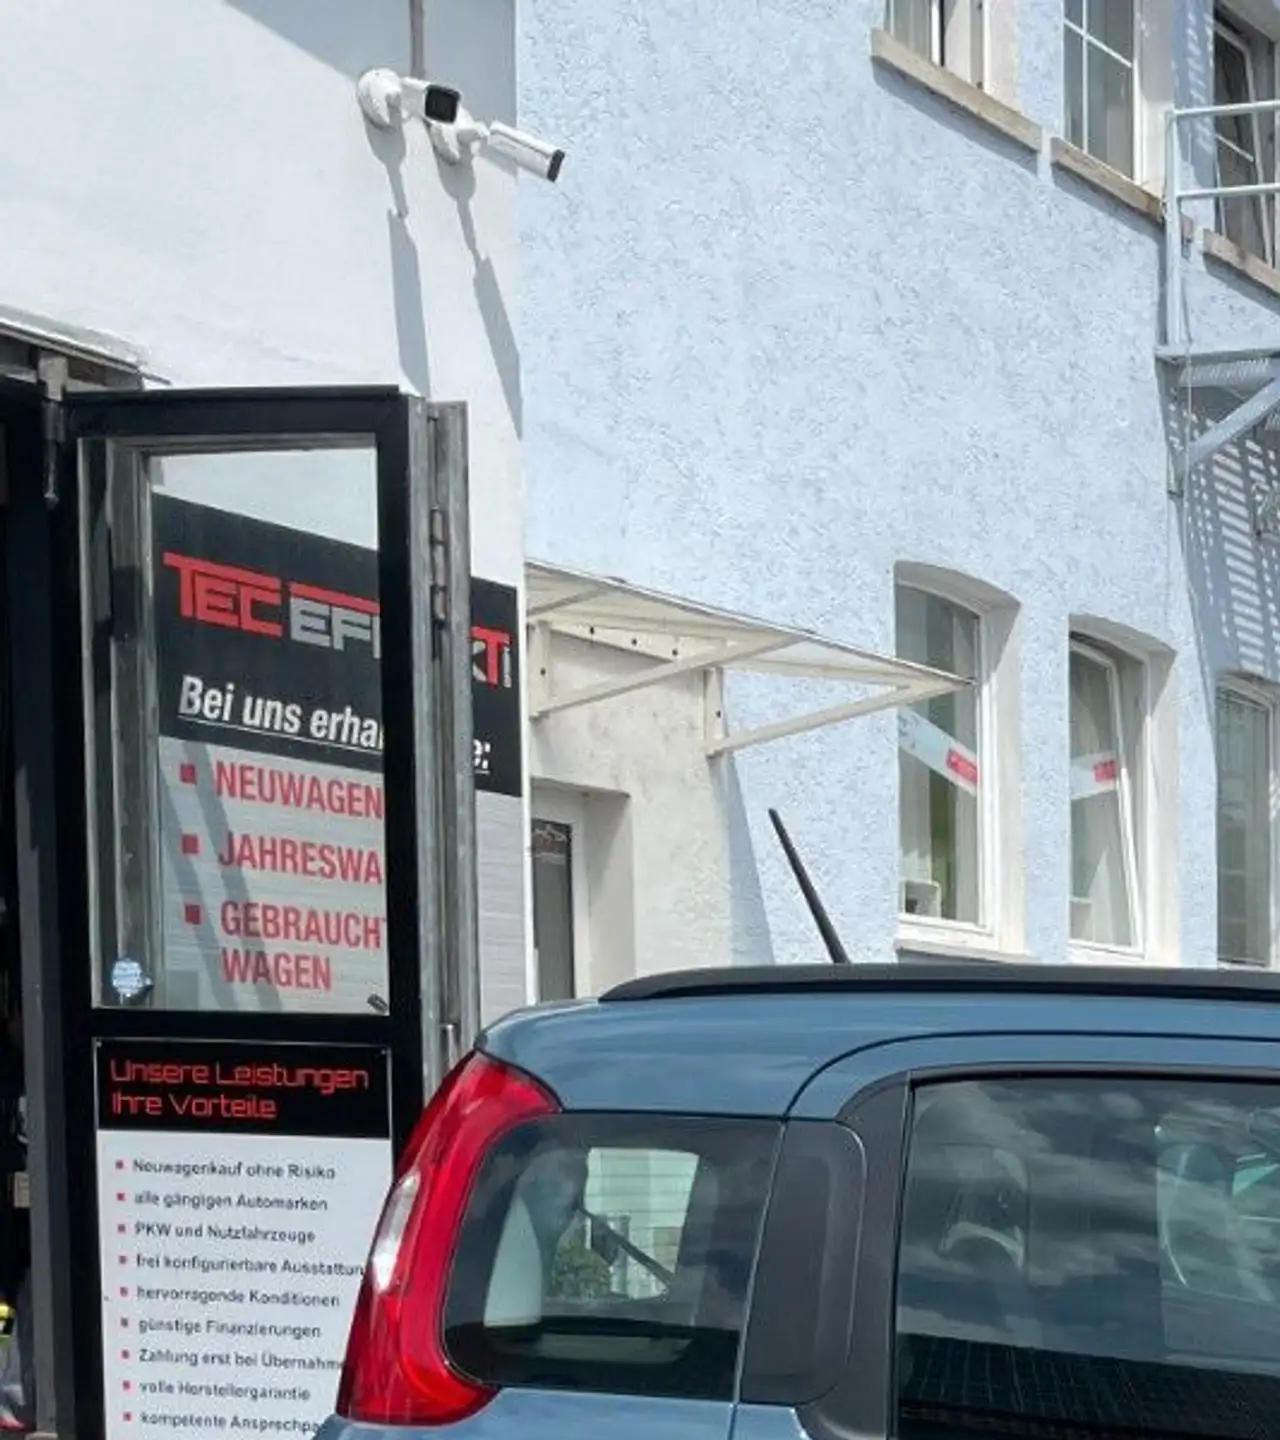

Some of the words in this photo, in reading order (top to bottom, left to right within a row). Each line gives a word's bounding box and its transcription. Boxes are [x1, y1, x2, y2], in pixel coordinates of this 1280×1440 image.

[163, 552, 283, 638] TEC
[178, 674, 235, 722] Bei
[242, 695, 302, 734] uns
[214, 760, 382, 819] NEUWAGEN
[218, 829, 383, 885] JAHRESWA
[220, 900, 387, 949] GEBRAUCH
[223, 947, 332, 990] WAGEN
[110, 1059, 209, 1084] Unsere
[215, 1062, 369, 1095] Leistungen
[111, 1091, 163, 1116] Ihre
[167, 1093, 278, 1119] Vorteile
[245, 1163, 285, 1179] ohne
[287, 1164, 336, 1180] Risiko
[236, 1193, 328, 1211] Automarken
[134, 1220, 171, 1238] PKW
[175, 1223, 204, 1239] und
[207, 1224, 316, 1246] Nutzfahrzeuge
[136, 1253, 160, 1269] frei
[136, 1286, 245, 1305] hervorragende
[249, 1290, 340, 1307] Konditionen
[206, 1320, 321, 1341] Finanzierungen
[139, 1348, 198, 1368] Zahlung
[202, 1352, 231, 1366] erst
[234, 1352, 257, 1368] bei
[139, 1380, 174, 1395] volle
[178, 1380, 311, 1402] Herstellergarantie
[140, 1411, 228, 1429] kompetente
